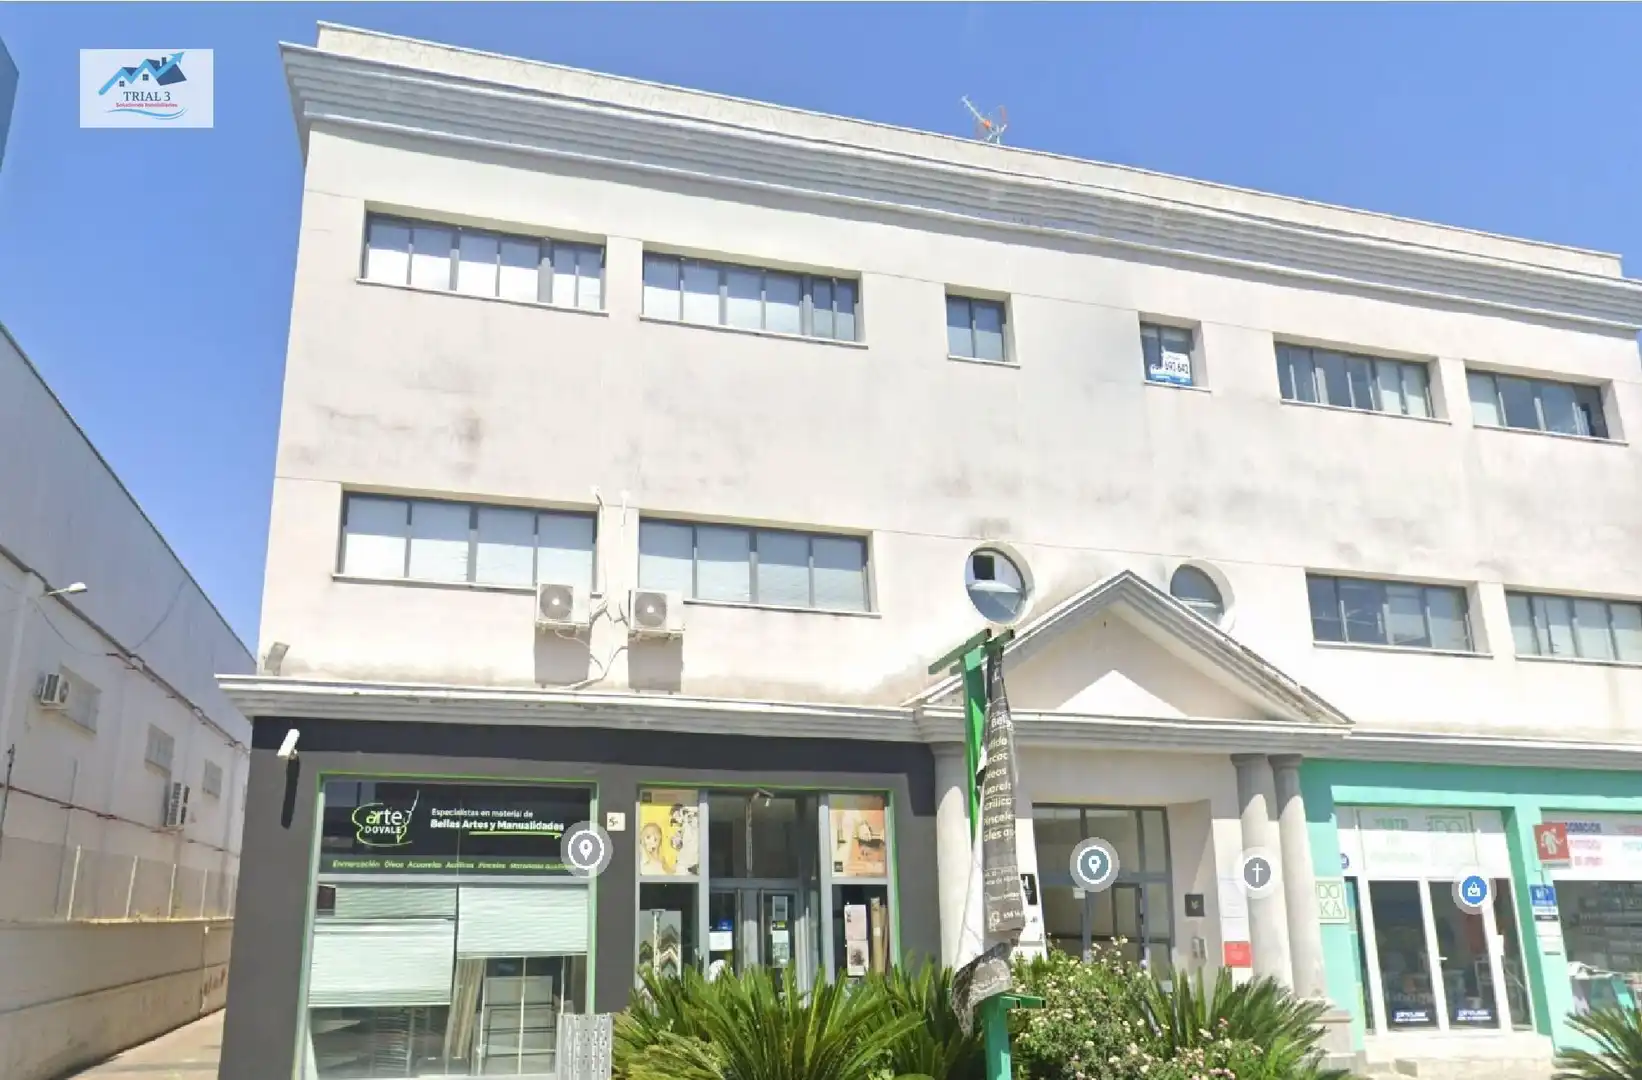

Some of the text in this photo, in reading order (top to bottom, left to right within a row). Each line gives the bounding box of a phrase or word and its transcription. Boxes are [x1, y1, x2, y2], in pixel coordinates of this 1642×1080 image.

[366, 808, 403, 826] arte
[431, 808, 479, 817] Especialistas
[491, 809, 522, 818] material
[523, 810, 533, 818] de
[364, 826, 402, 834] DOVALE
[430, 819, 565, 831] Bellas Artes y Manualidades
